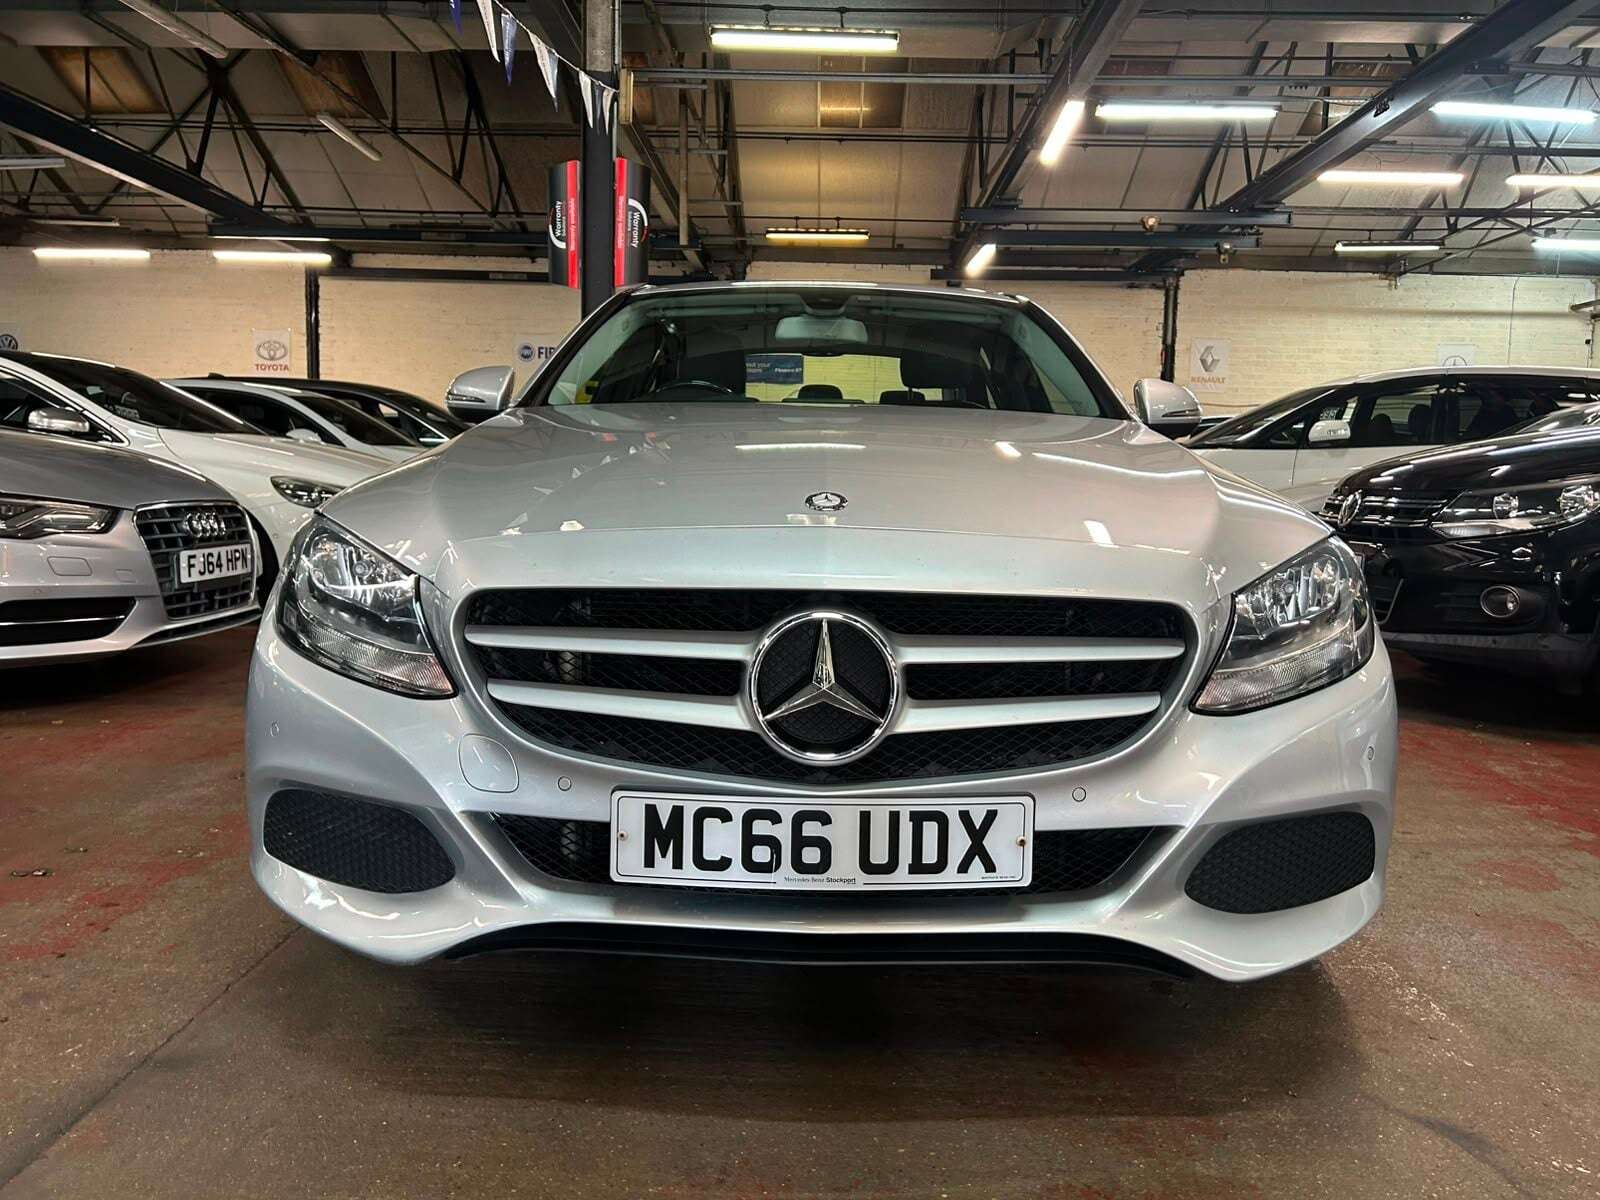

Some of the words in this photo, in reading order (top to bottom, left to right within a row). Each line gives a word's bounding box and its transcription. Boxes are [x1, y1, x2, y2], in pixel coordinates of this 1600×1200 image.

[631, 211, 641, 248] Warranty
[255, 363, 289, 371] TOYOTA
[187, 551, 223, 578] FJ64
[226, 547, 248, 572] HPN
[643, 804, 832, 875] MC66
[858, 809, 998, 875] UDX
[826, 877, 857, 885] Stockport
